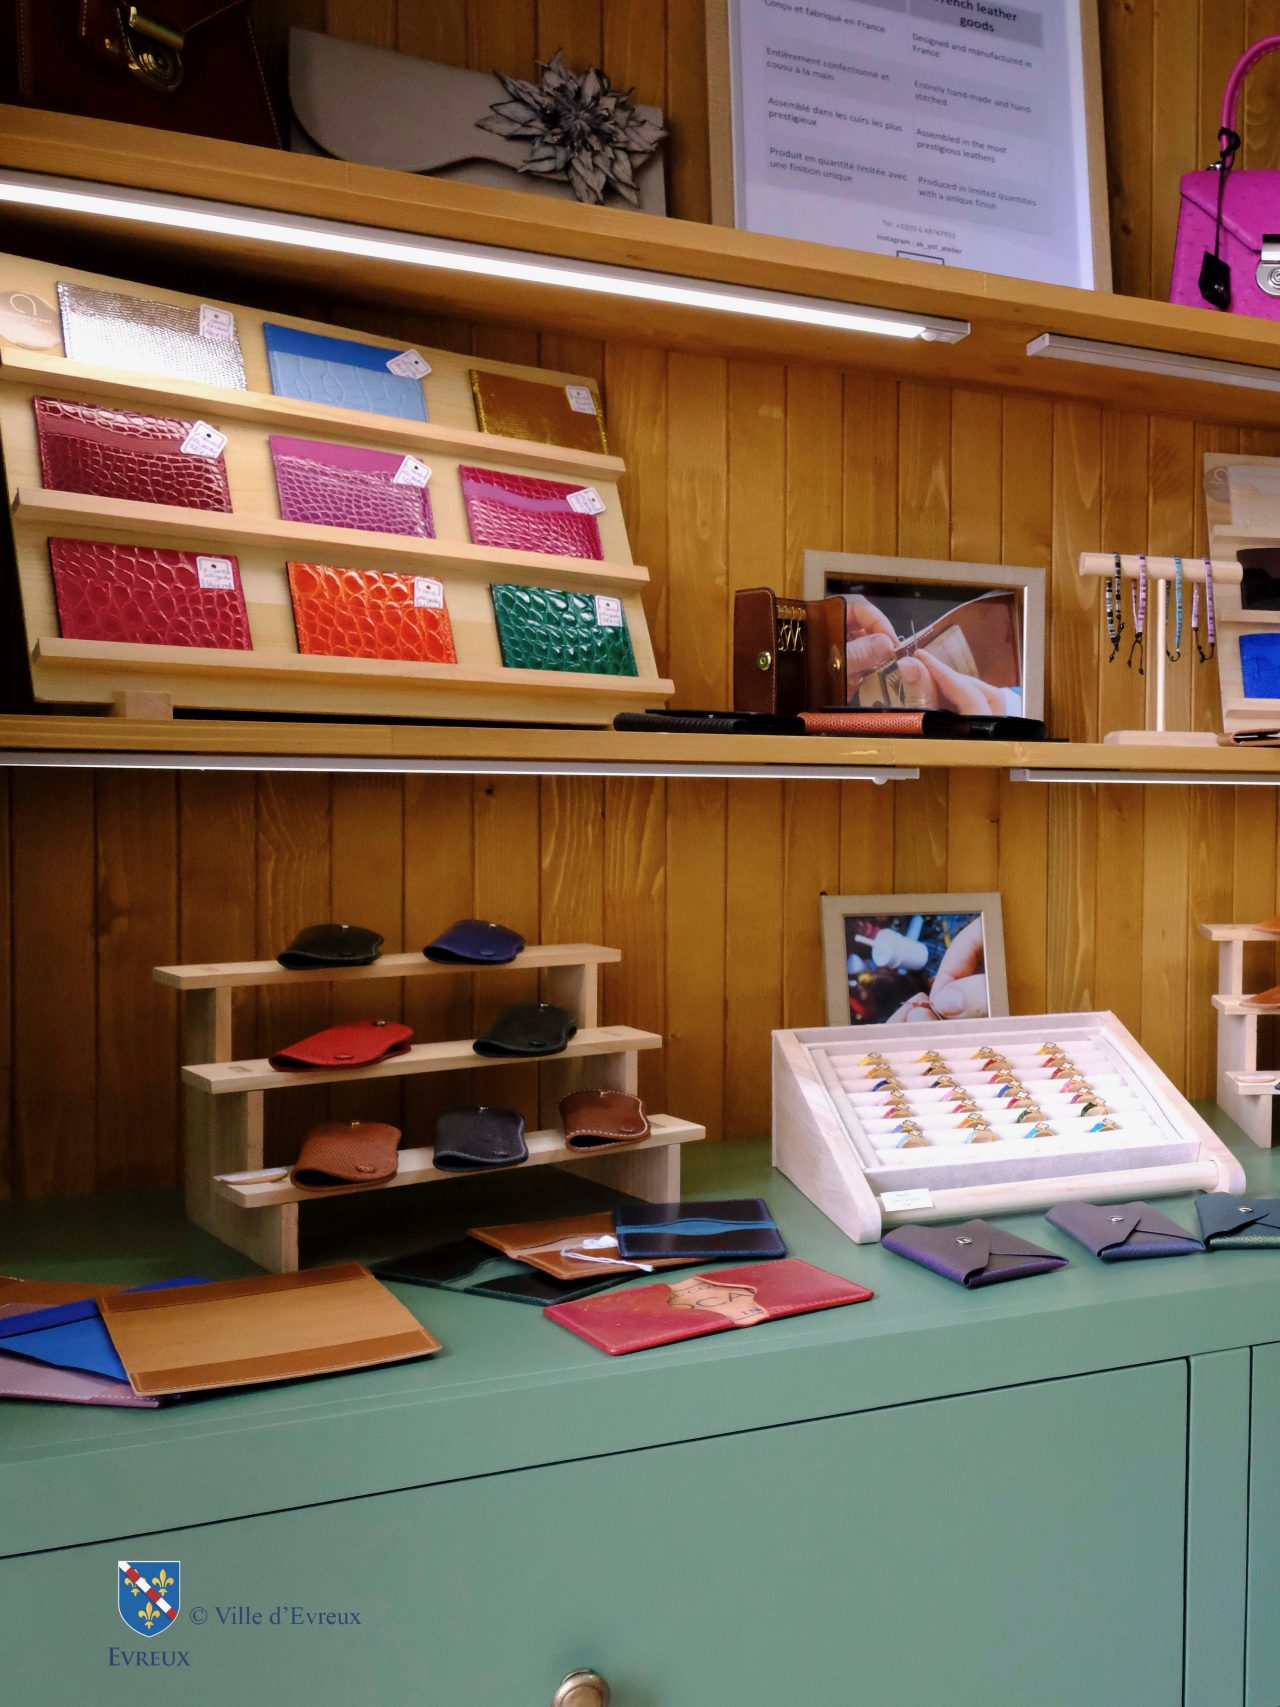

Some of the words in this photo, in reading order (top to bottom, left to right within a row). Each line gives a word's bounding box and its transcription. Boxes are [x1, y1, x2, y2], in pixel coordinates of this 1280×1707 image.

[806, 7, 842, 22] fabriqué
[844, 17, 855, 26] en
[857, 19, 885, 33] France
[935, 0, 973, 11] rench
[976, 2, 1017, 20] leather
[960, 17, 994, 32] goods
[912, 33, 949, 48] Designed
[951, 43, 967, 53] and
[968, 46, 1023, 66] manufactured
[912, 44, 940, 58] France
[766, 47, 821, 65] Entièrement
[823, 60, 879, 78] confectionné
[766, 61, 793, 72] cousu
[812, 70, 834, 81] main
[914, 80, 945, 95] Entirely
[947, 84, 993, 104] hand-made
[914, 93, 947, 106] stitched
[768, 97, 810, 112] Assemblé
[813, 106, 834, 118] dans
[849, 114, 869, 126] cuirs
[885, 121, 903, 132] plus
[768, 110, 817, 126] prestigieux
[916, 128, 960, 144] Assembled
[986, 144, 1007, 154] most
[916, 141, 961, 156] prestigious
[962, 149, 995, 163] leathers
[769, 146, 802, 161] Produit
[818, 155, 854, 171] quantité
[856, 162, 886, 177] limitée
[888, 170, 908, 181] avec
[770, 160, 790, 170] une
[789, 162, 821, 176] finition
[822, 170, 853, 182] unique
[918, 176, 957, 191] Produced
[968, 186, 996, 199] limited
[918, 189, 937, 199] with
[945, 195, 974, 207] unique
[975, 198, 997, 210] finish
